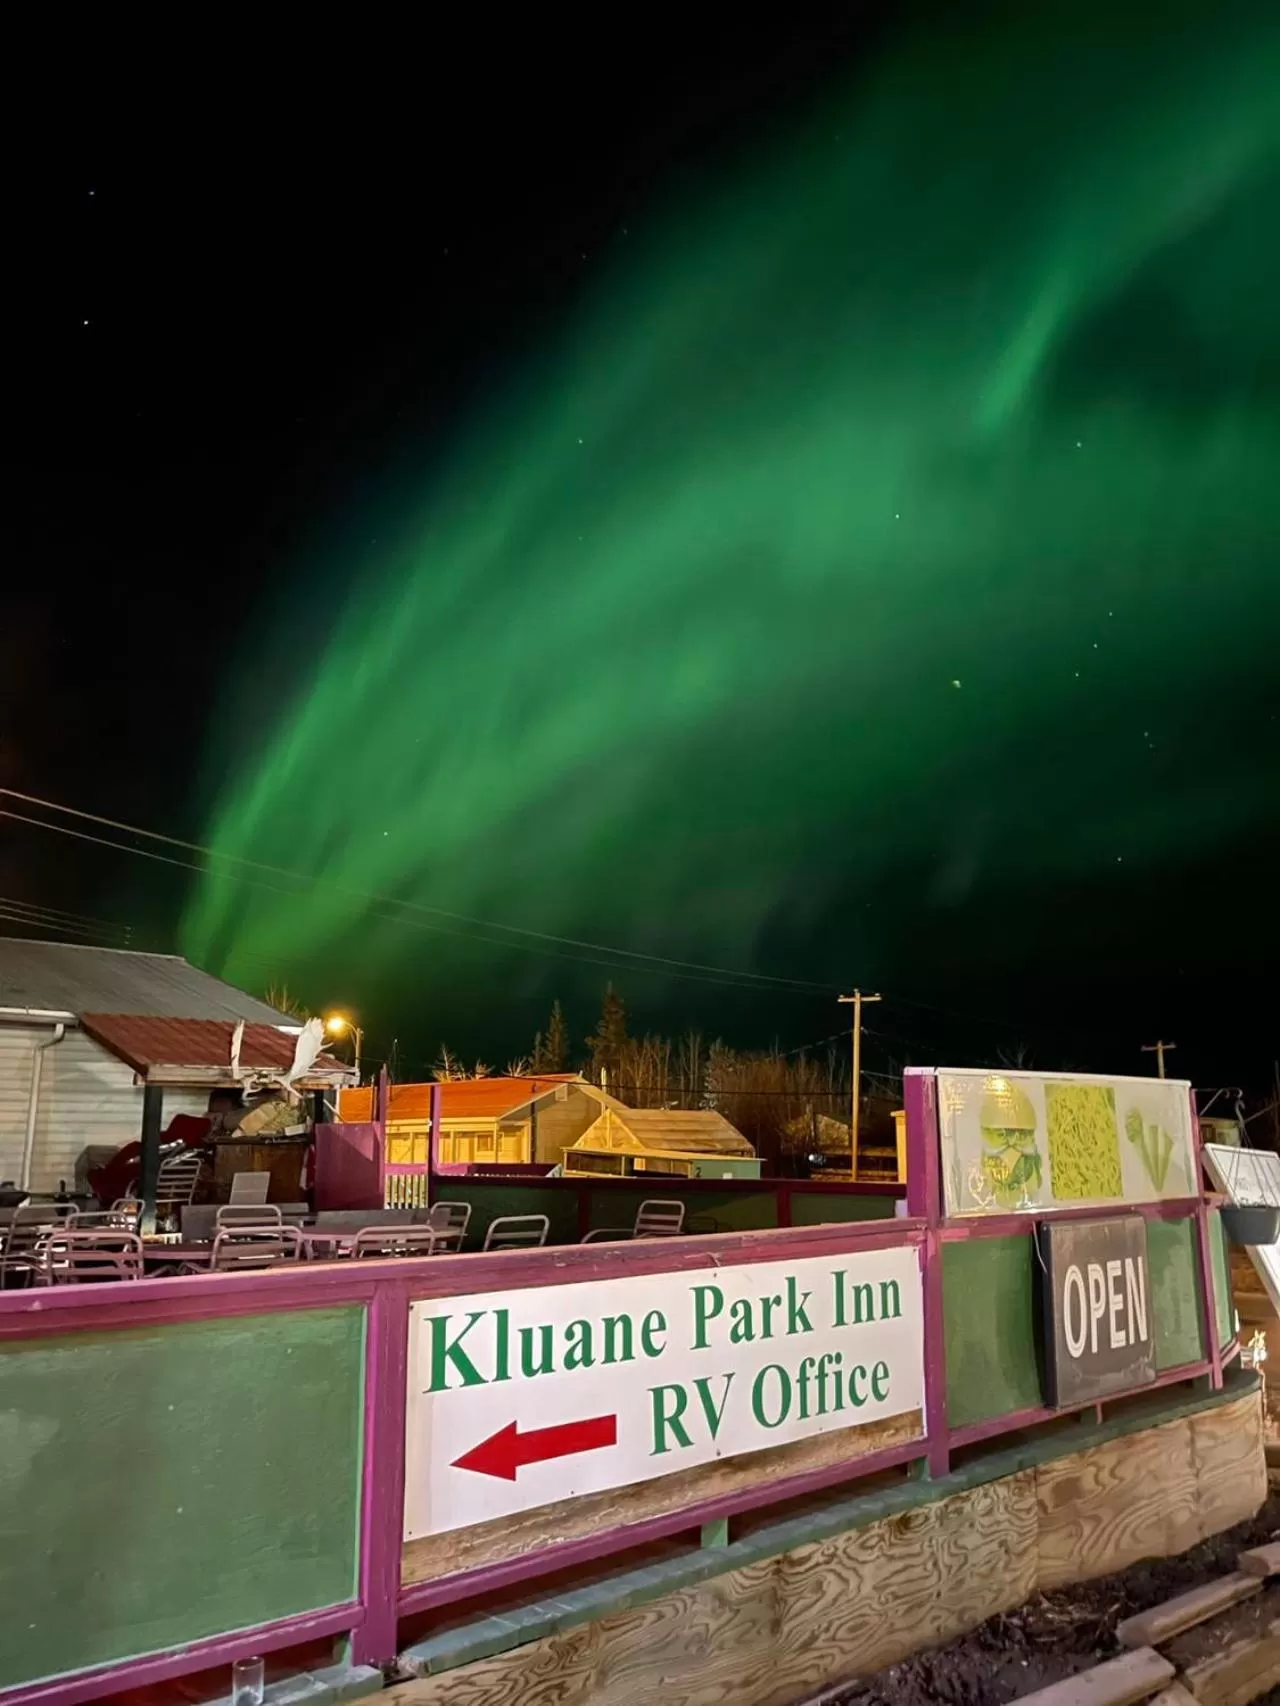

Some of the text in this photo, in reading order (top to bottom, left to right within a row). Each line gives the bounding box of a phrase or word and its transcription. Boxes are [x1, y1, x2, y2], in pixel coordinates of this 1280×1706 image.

[422, 1269, 904, 1394] Kluane Park Inn
[1063, 1257, 1148, 1358] OPEN
[646, 1351, 891, 1456] RV Office
